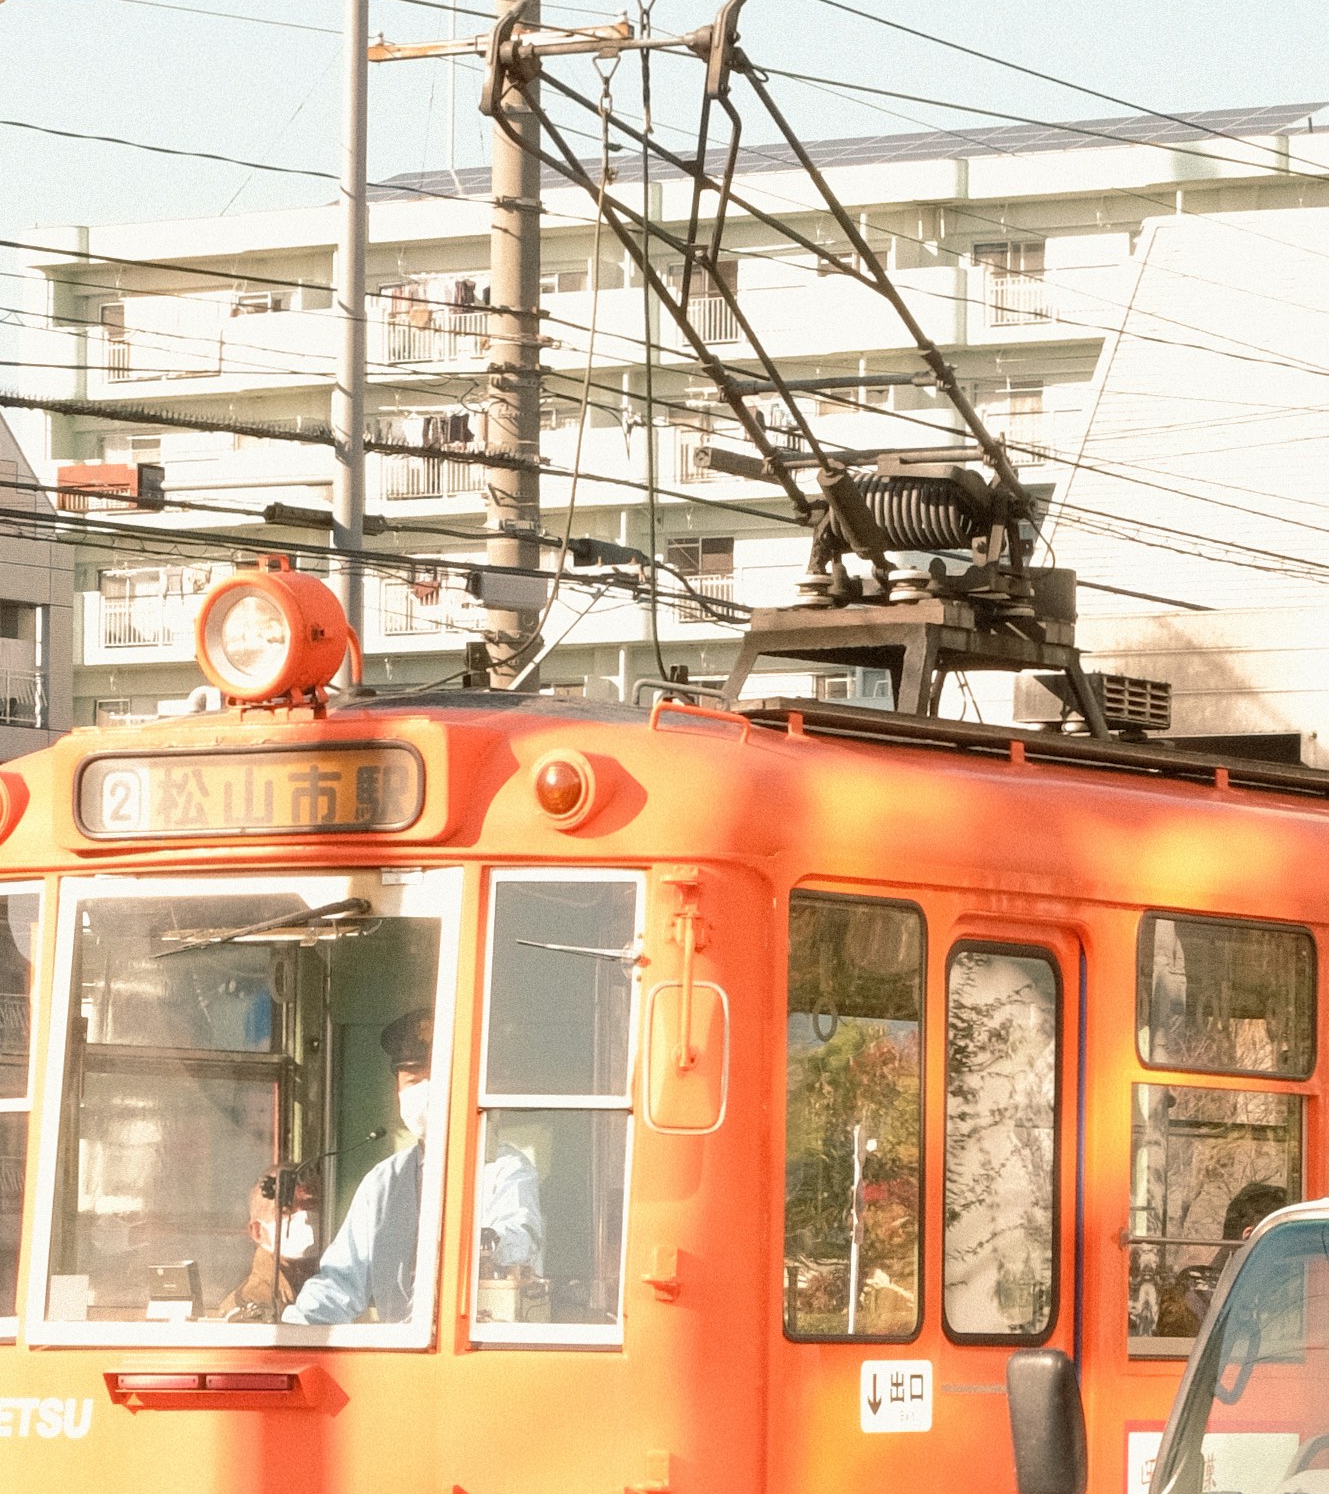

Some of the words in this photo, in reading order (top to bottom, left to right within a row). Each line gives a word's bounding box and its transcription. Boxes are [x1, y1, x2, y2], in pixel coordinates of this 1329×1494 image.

[109, 779, 133, 822] 2
[157, 764, 409, 825] 松山市駅
[890, 1371, 924, 1403] 出口
